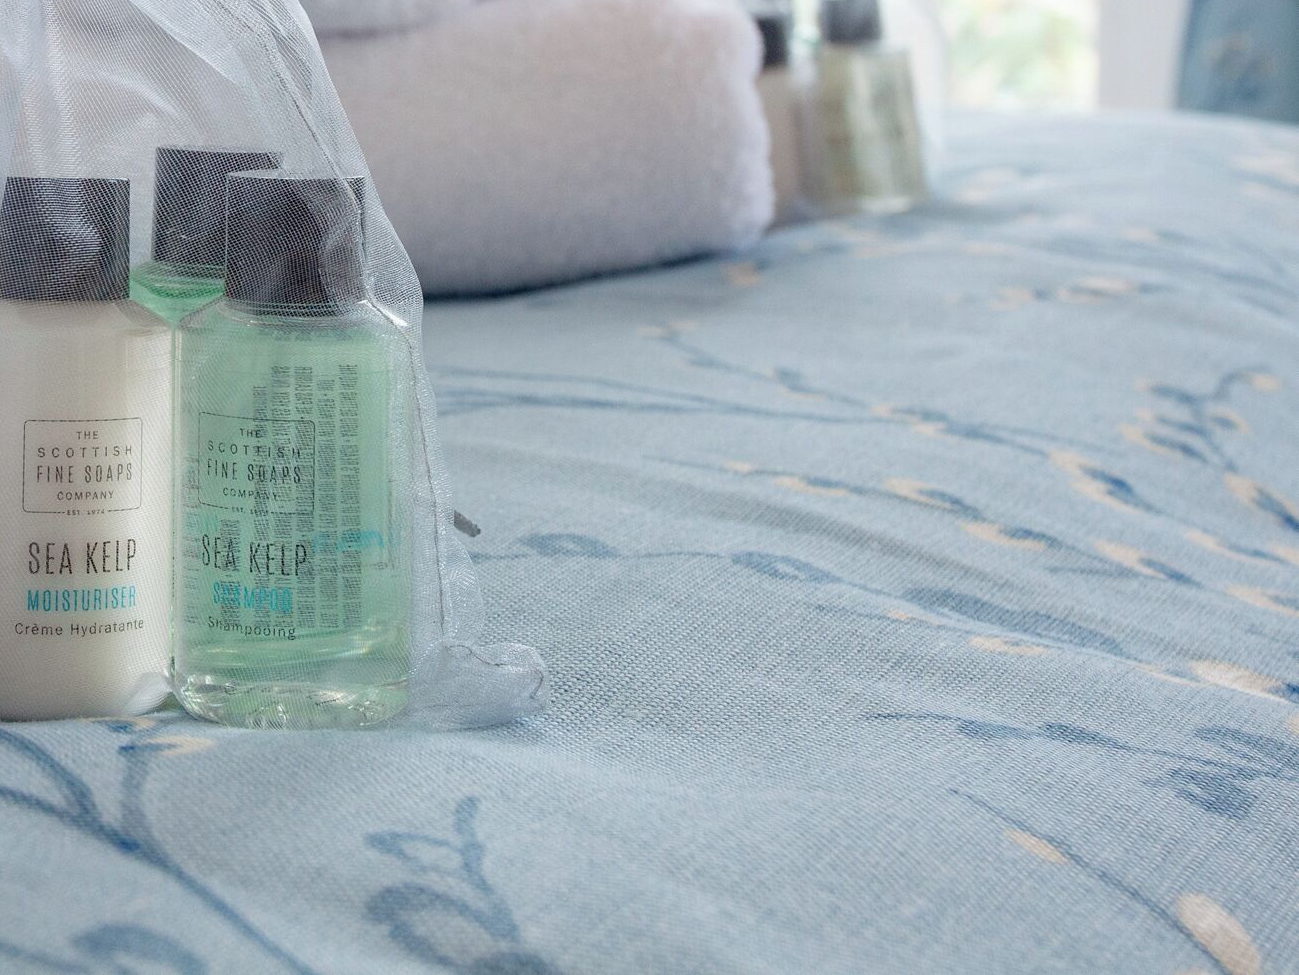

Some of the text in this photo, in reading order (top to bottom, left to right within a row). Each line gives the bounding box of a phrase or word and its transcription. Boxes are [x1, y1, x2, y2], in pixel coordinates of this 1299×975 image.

[76, 430, 99, 440] THE
[239, 428, 262, 438] THE
[37, 445, 132, 458] SCOTTISH
[207, 440, 301, 458] SCOTTISH
[36, 462, 132, 483] FINE SOAPS
[207, 458, 301, 484] FINE SOAPS
[56, 490, 115, 501] COMPANY
[28, 538, 136, 575] SEA KELP
[202, 533, 237, 569] SEA
[249, 541, 307, 576] KELP
[27, 585, 136, 612] MOISTURISER
[14, 619, 144, 638] Crème Hydratante
[207, 615, 297, 641] Shampooing
